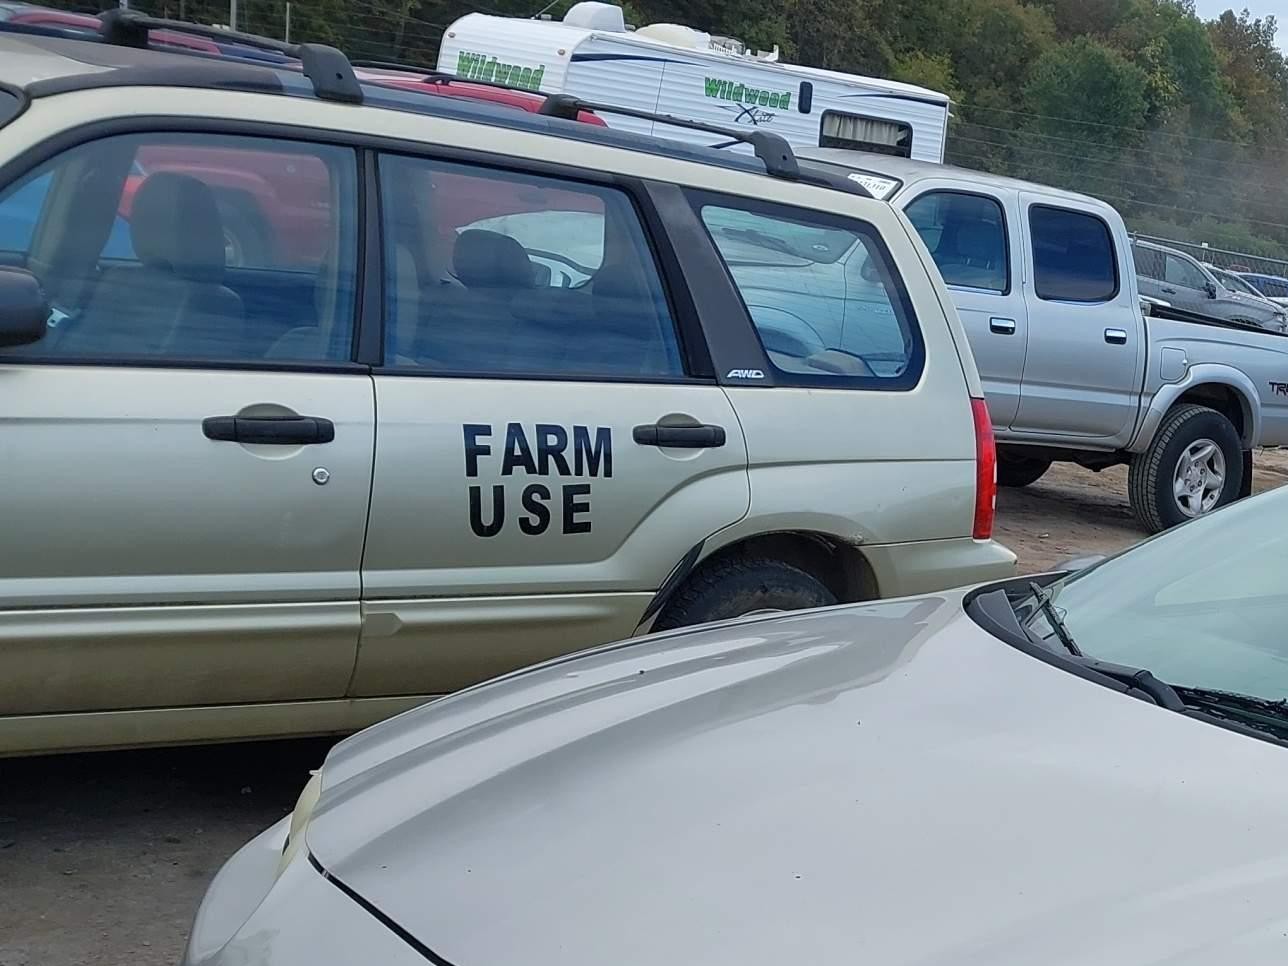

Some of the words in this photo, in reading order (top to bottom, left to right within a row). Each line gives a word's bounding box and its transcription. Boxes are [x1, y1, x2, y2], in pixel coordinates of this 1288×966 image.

[457, 50, 545, 91] Wildwood
[704, 76, 792, 110] Wildwood
[727, 369, 765, 378] AWD
[463, 422, 613, 478] FARM
[469, 483, 592, 538] USE
